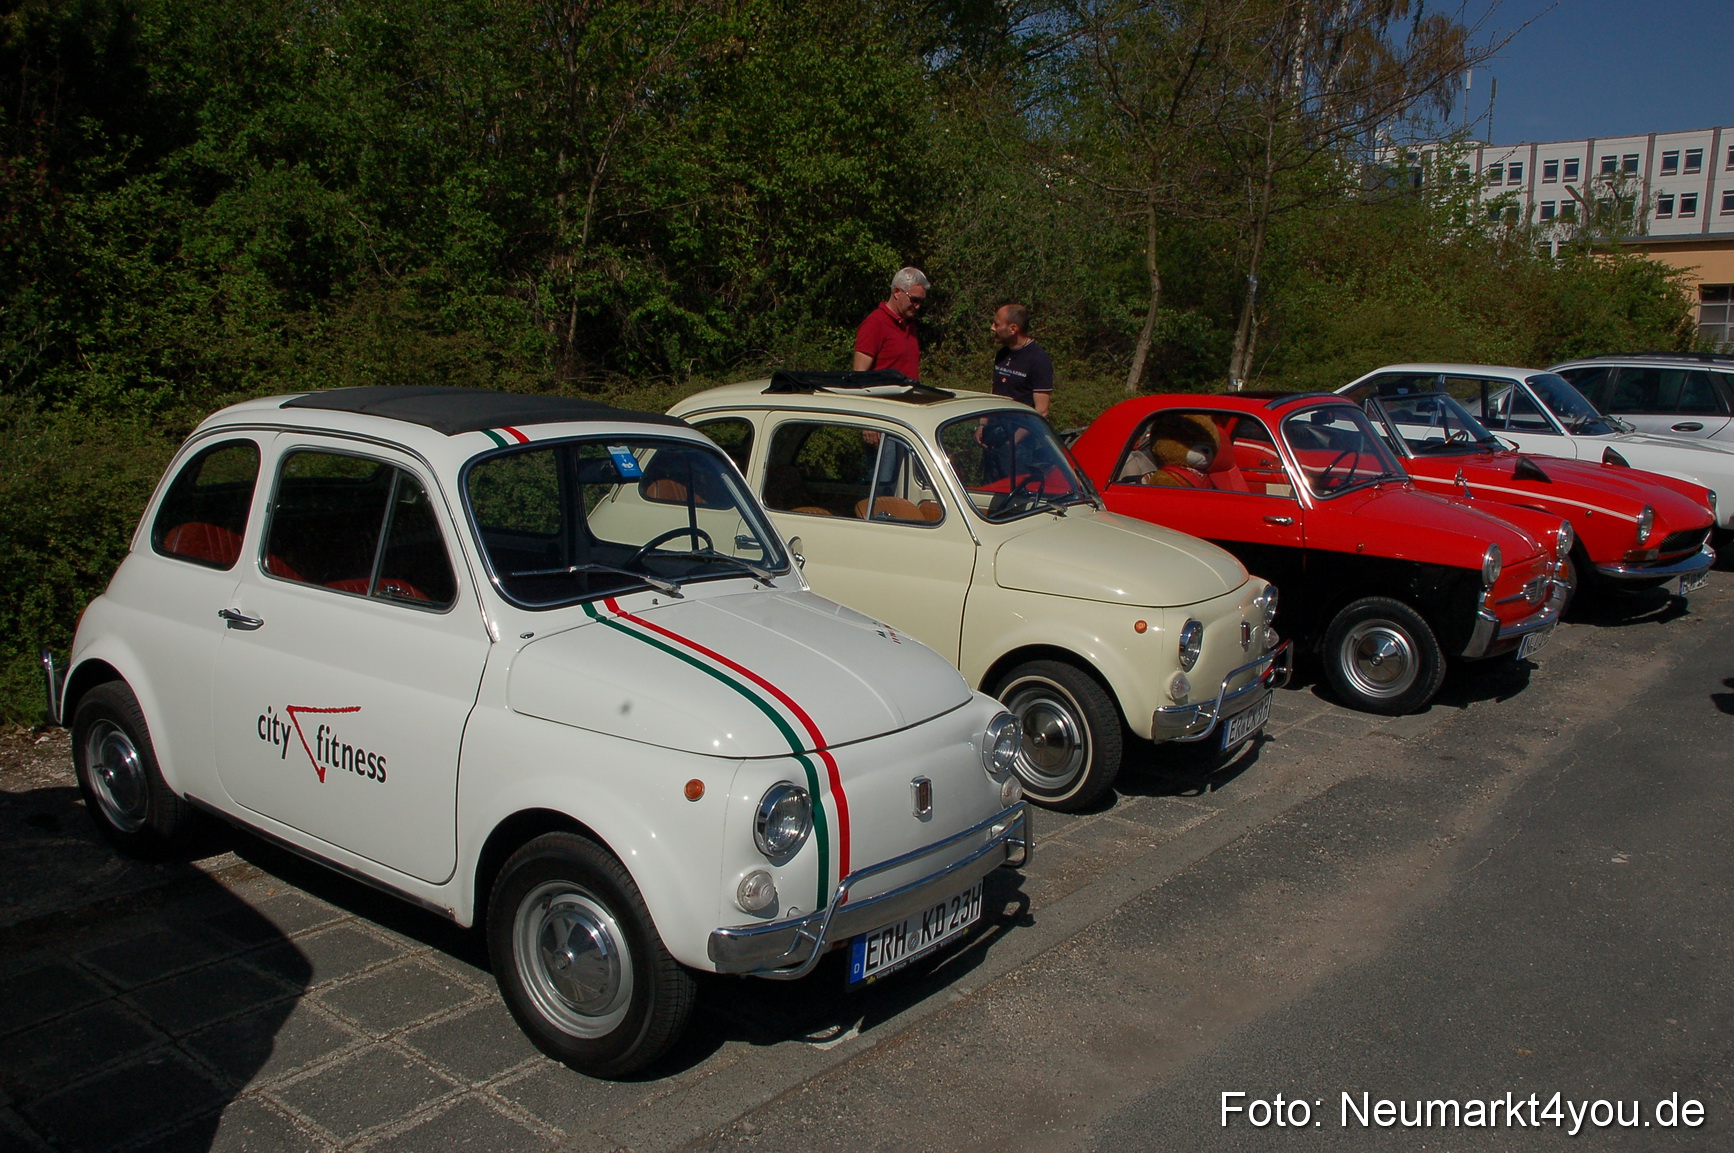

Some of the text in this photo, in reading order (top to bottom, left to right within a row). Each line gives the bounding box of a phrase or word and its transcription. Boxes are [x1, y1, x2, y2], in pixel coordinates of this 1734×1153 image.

[257, 705, 387, 784] city fitness
[865, 920, 908, 972] ERH
[921, 902, 947, 946] KD
[949, 883, 982, 931] 23H
[853, 962, 861, 975] D
